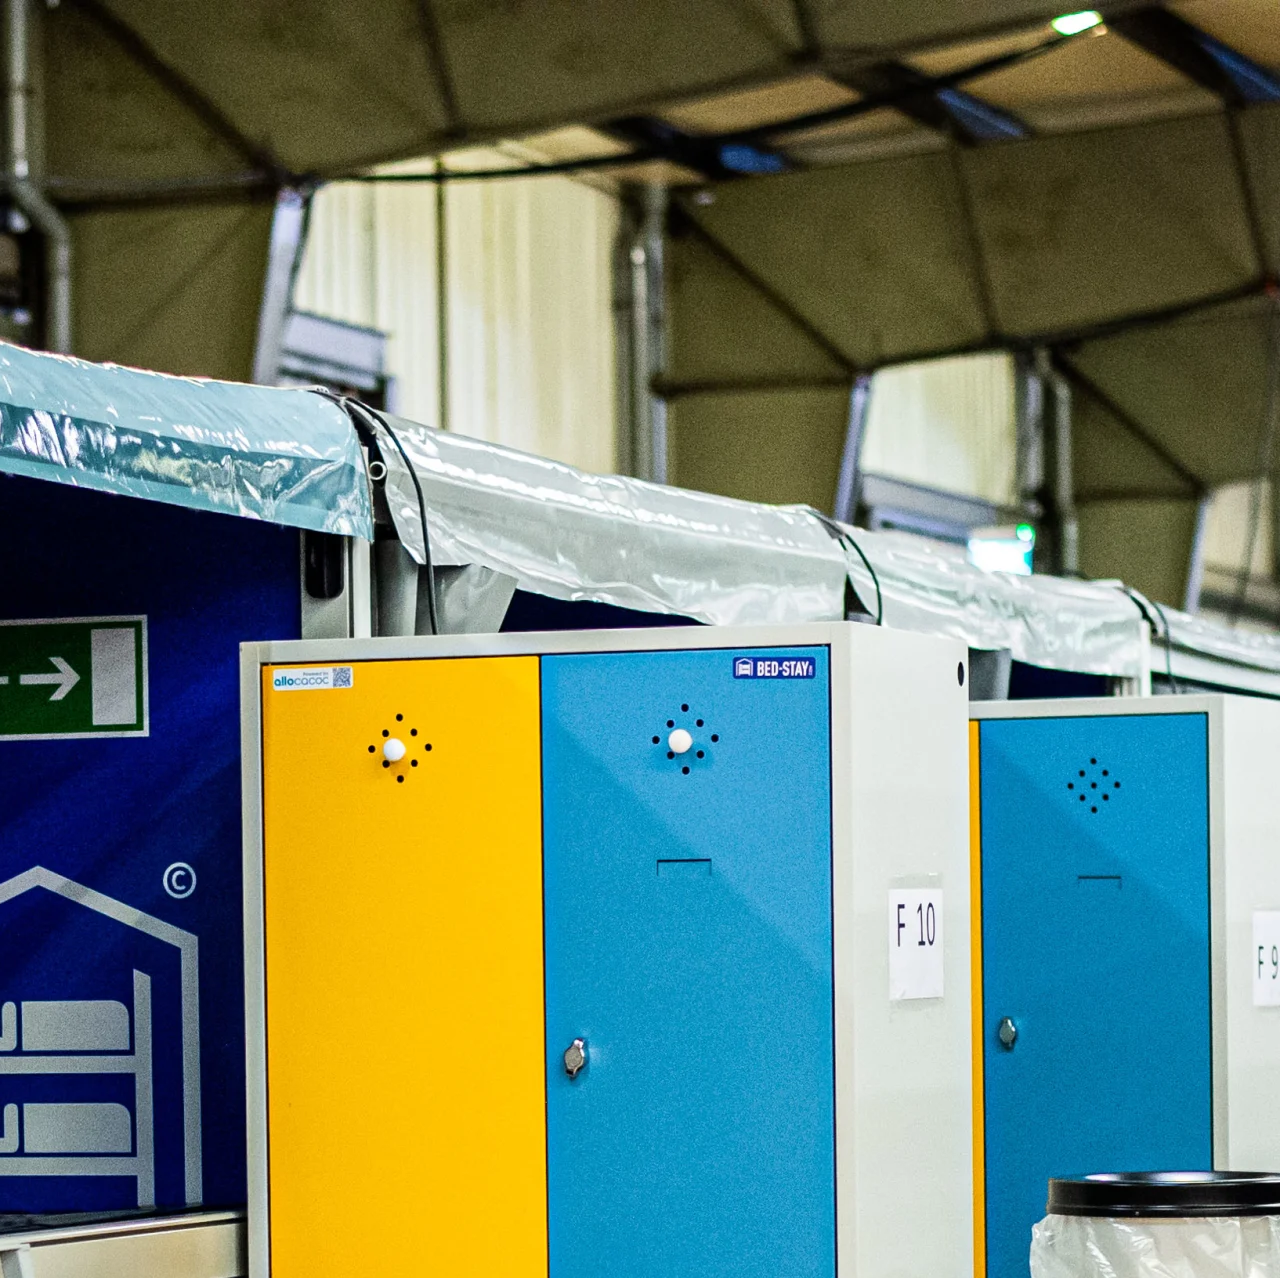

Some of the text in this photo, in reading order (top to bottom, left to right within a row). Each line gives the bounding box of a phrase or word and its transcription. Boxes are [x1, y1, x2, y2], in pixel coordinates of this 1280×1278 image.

[274, 676, 329, 687] allocacoc
[757, 660, 809, 677] BED-STAY
[897, 902, 936, 947] F 10
[1258, 945, 1279, 980] F 9
